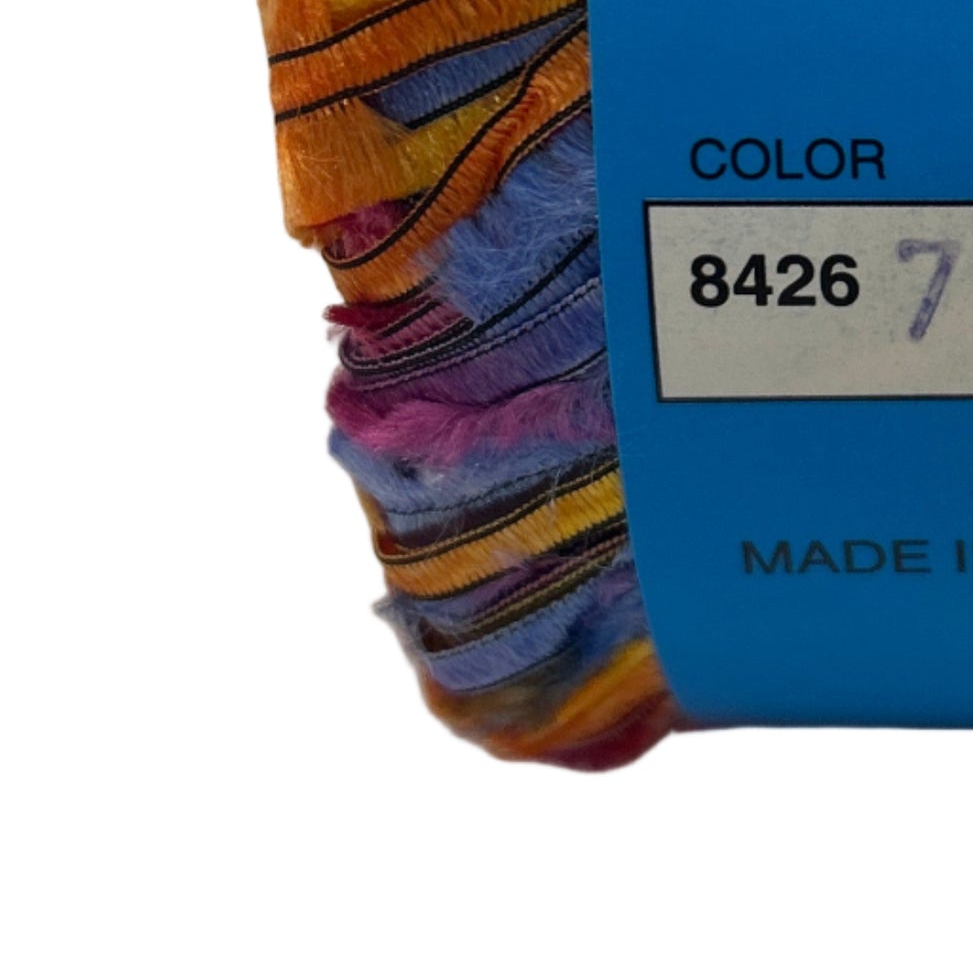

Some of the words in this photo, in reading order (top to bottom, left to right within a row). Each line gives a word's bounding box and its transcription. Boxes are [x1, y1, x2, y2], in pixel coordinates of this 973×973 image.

[689, 138, 887, 180] COLOR
[689, 253, 860, 308] 8426
[740, 539, 931, 575] MADE
